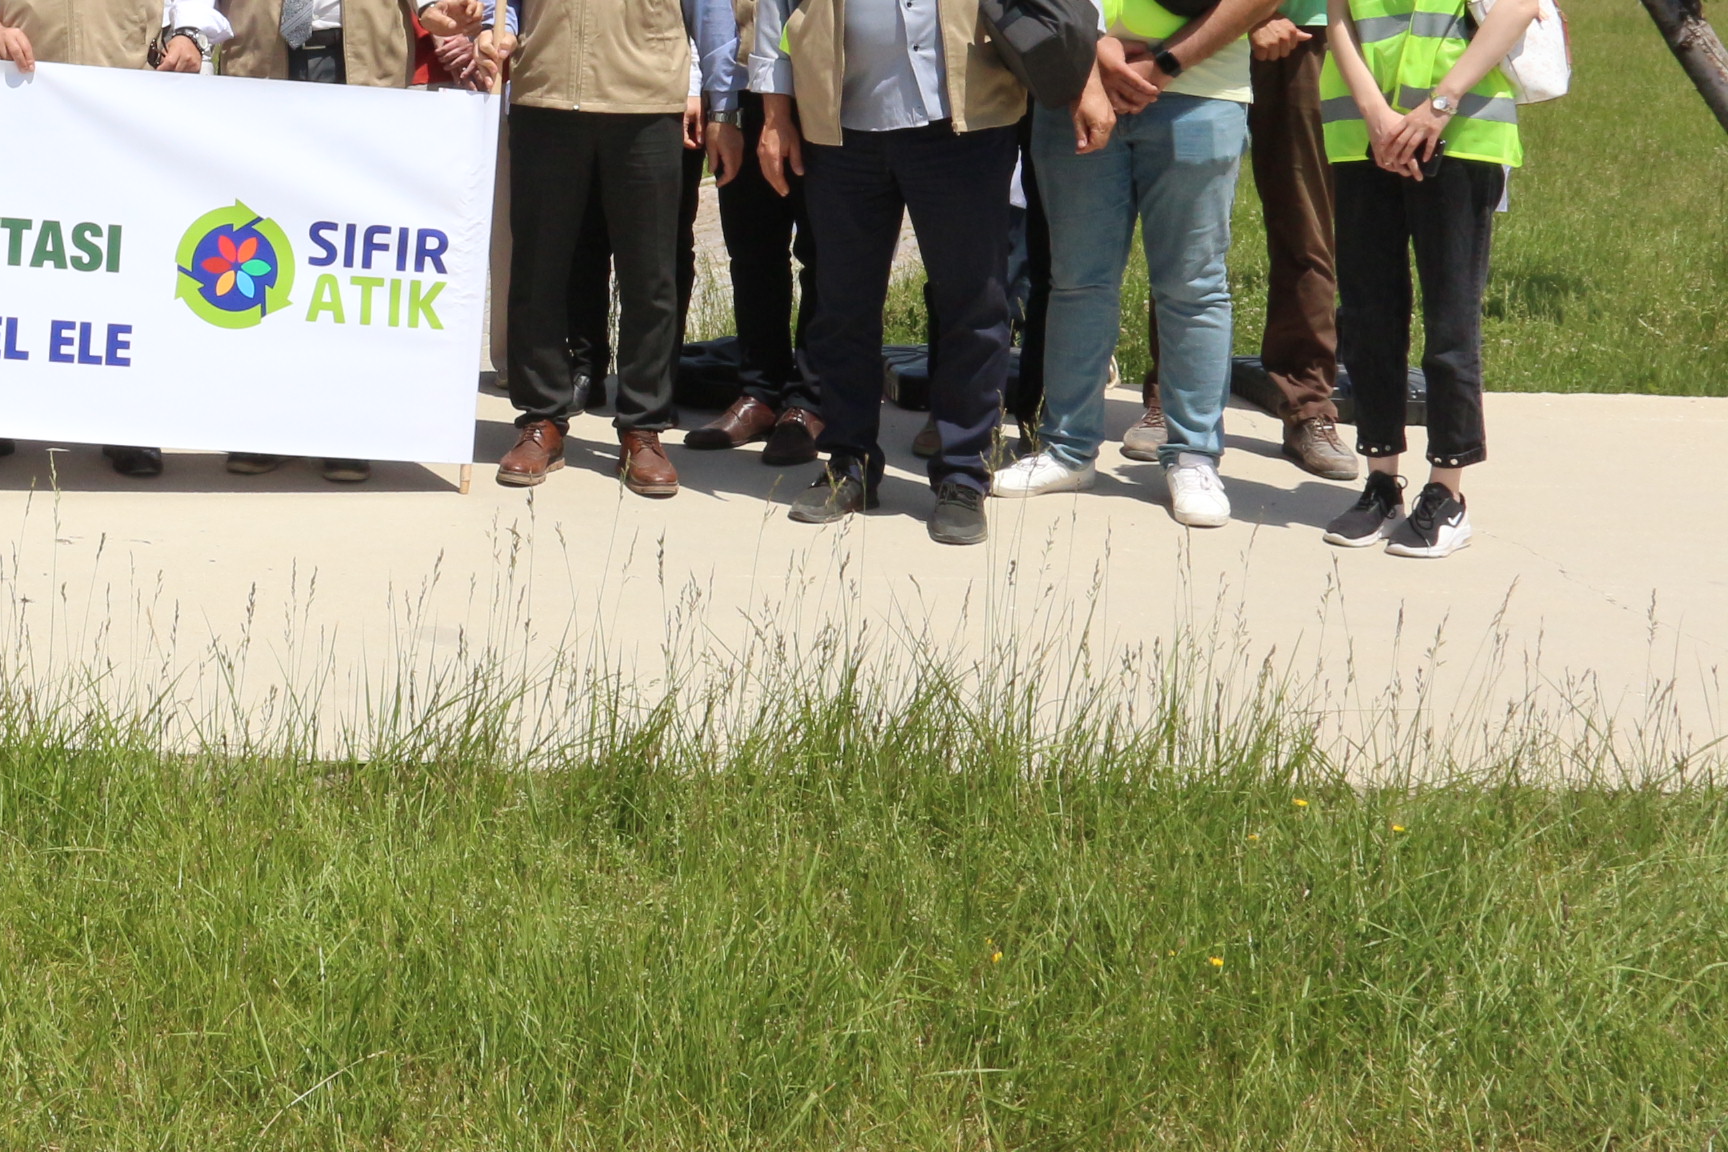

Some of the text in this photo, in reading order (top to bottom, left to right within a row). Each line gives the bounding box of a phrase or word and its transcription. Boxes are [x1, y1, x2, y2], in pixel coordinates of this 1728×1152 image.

[308, 220, 450, 275] SIFIR
[306, 273, 448, 331] ATIK
[49, 319, 134, 369] ELE
